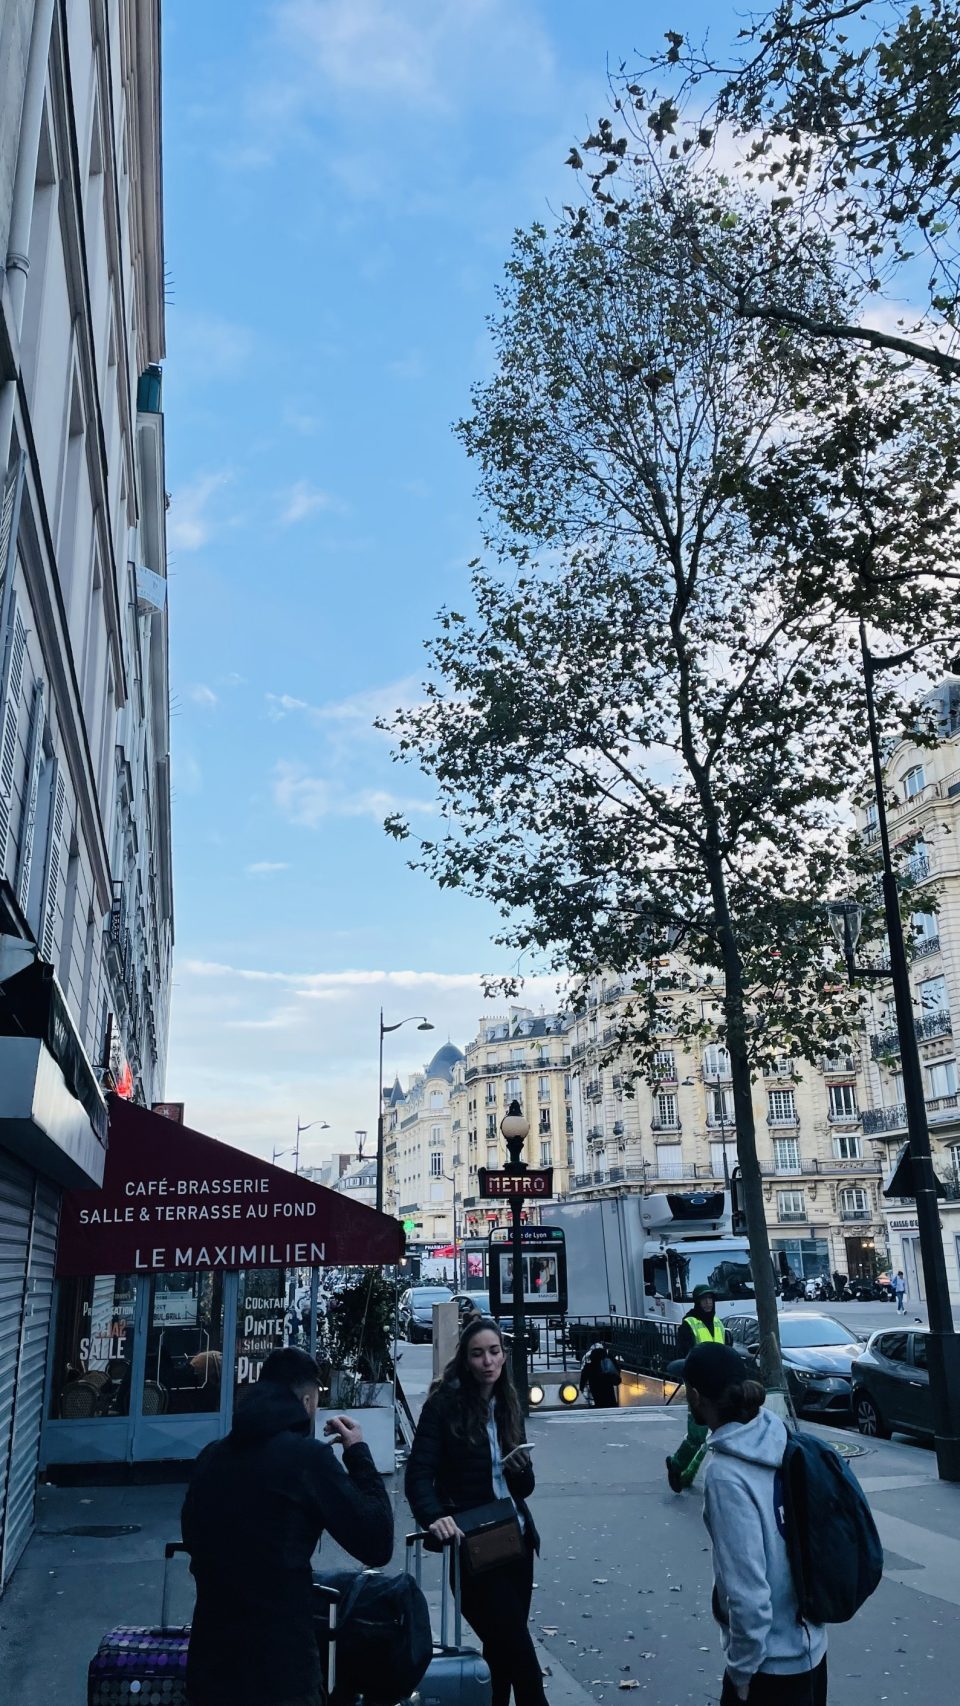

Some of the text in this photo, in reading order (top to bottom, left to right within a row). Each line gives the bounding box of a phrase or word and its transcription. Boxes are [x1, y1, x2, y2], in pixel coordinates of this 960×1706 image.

[125, 1178, 269, 1196] CAFÉ-BRASSERIE
[79, 1202, 317, 1224] SALLE & TERRASSE AU FOND
[533, 1232, 548, 1240] Lyon
[135, 1242, 326, 1269] LE MAXIMILIEN
